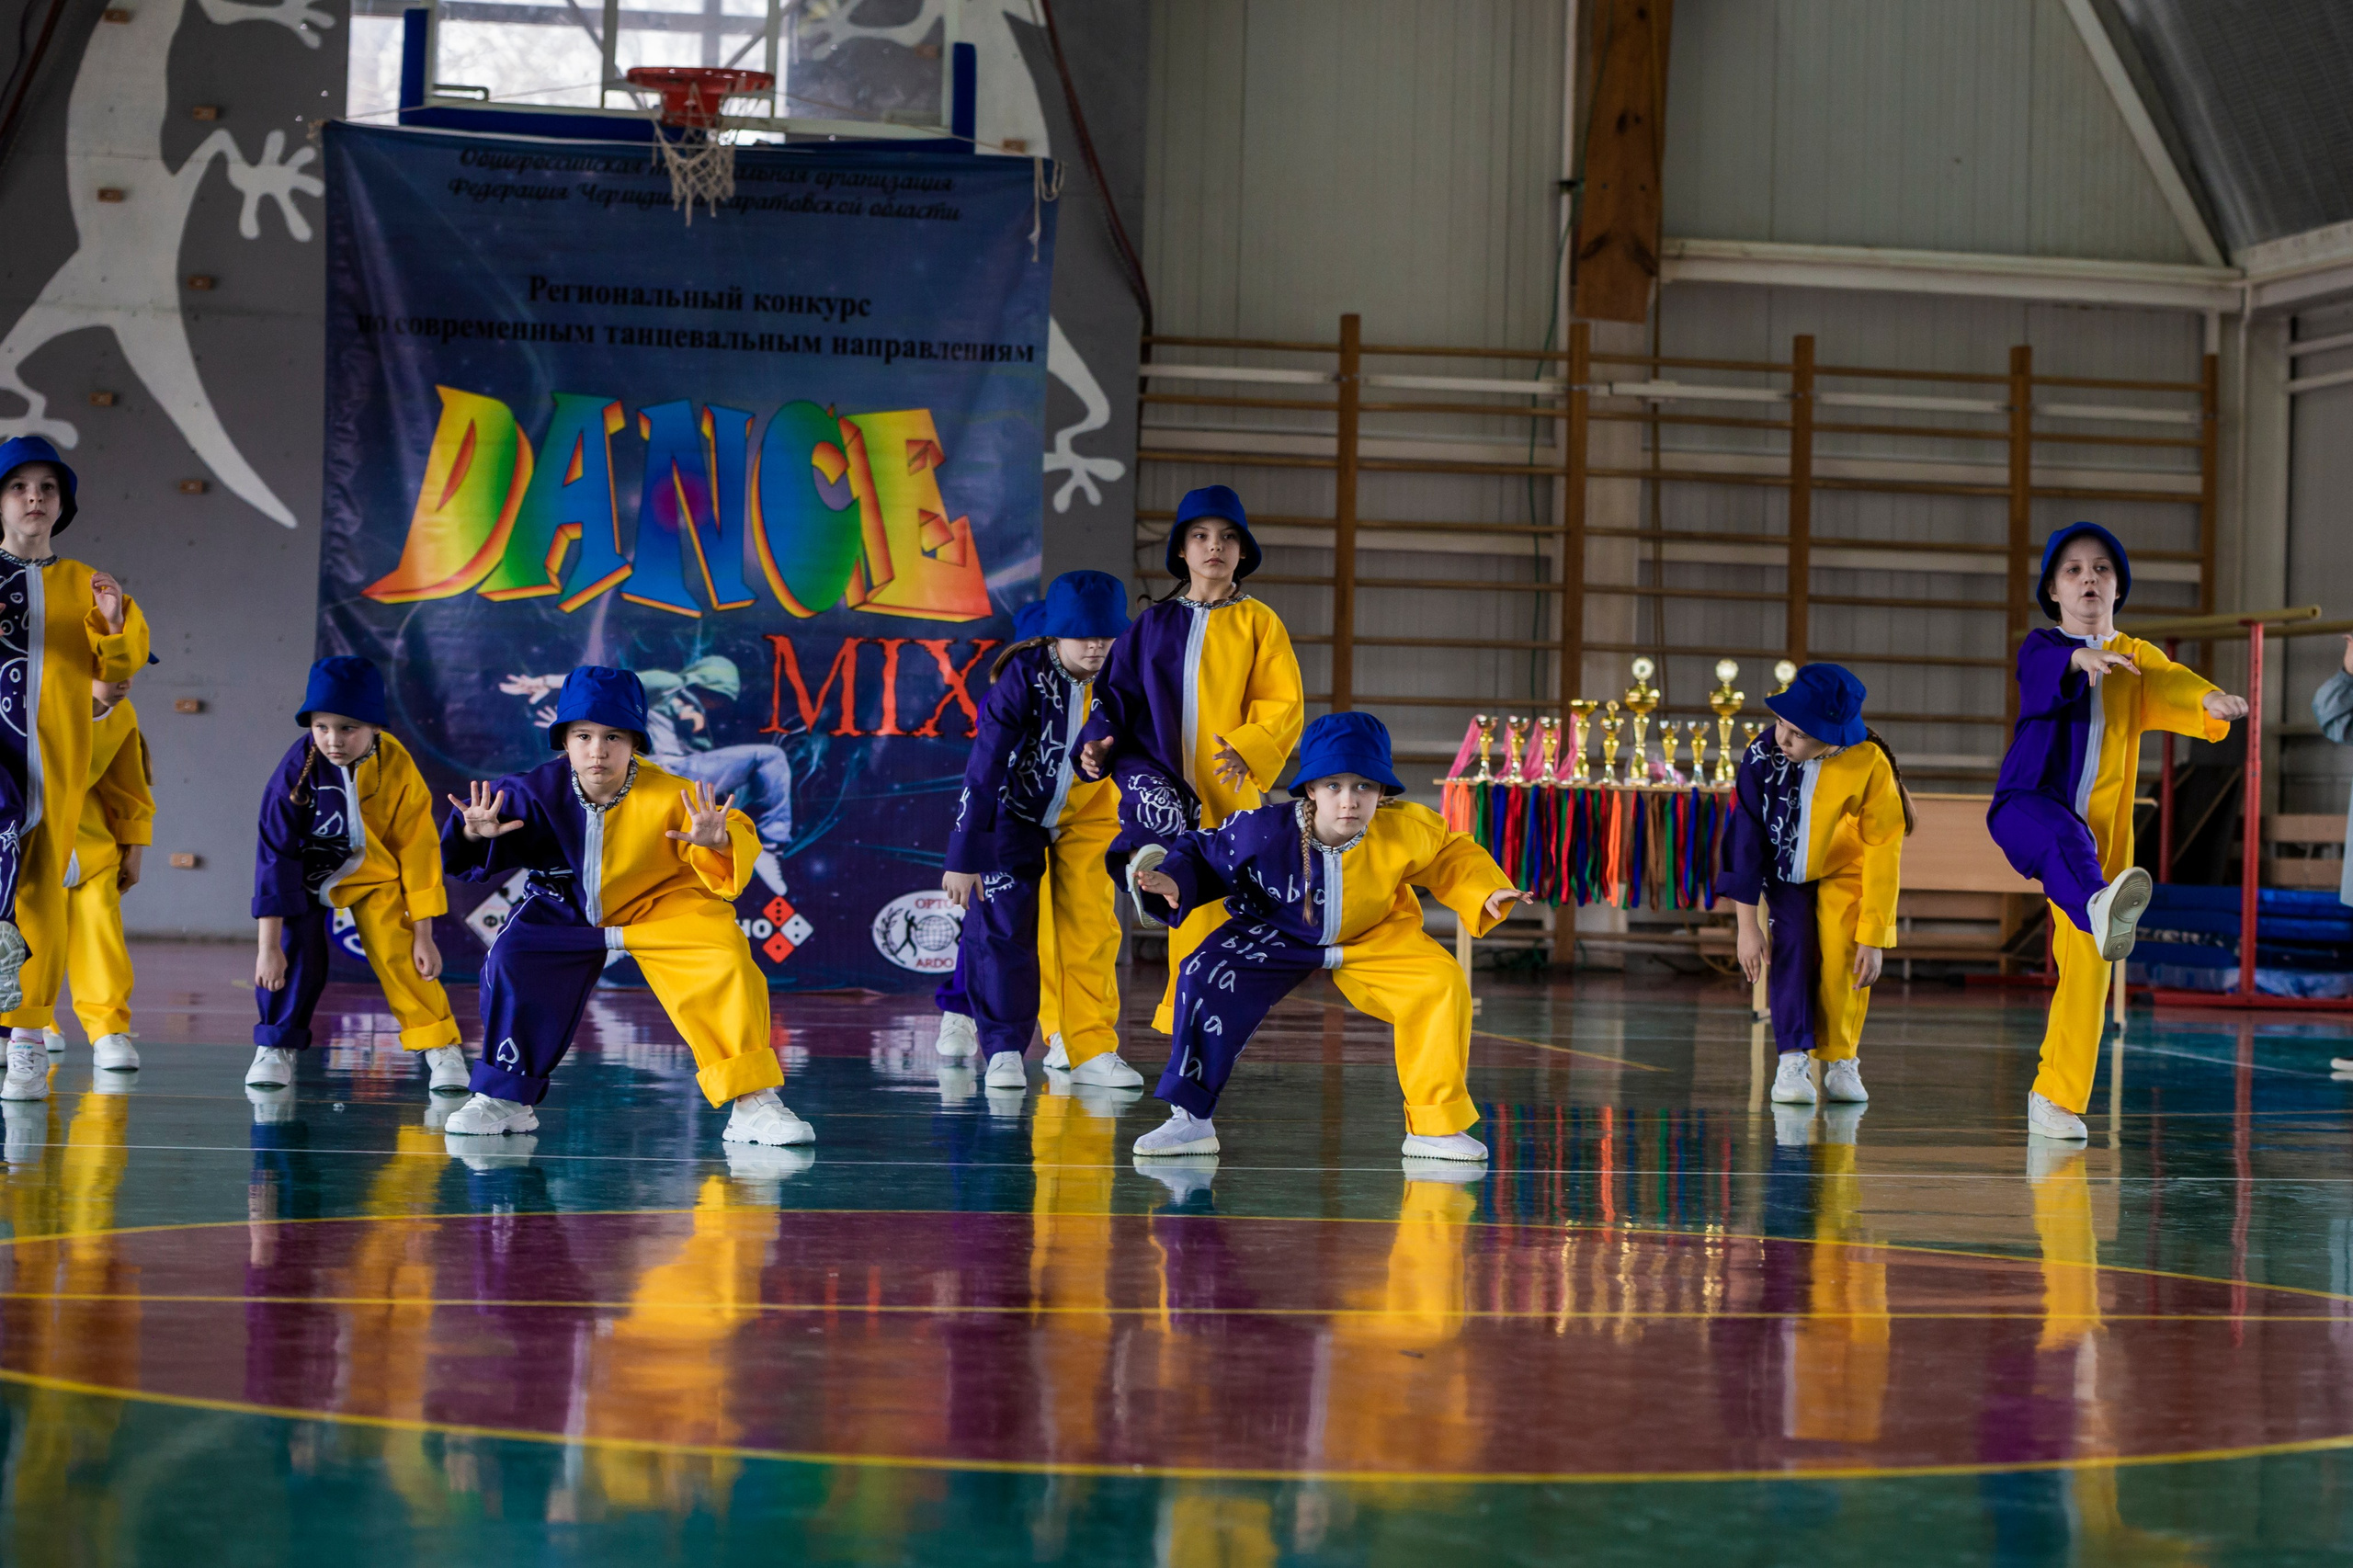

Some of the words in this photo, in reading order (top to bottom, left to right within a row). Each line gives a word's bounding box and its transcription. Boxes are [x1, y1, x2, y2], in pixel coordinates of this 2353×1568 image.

[448, 178, 570, 203] Федерация
[870, 195, 960, 222] области
[815, 171, 954, 194] организация
[529, 275, 744, 312] Региональный
[753, 292, 872, 323] конкурс
[357, 313, 388, 335] по
[394, 315, 595, 345] современным
[605, 324, 823, 356] танцевальным
[832, 333, 1035, 365] направлениям
[359, 383, 994, 624] DANCE
[759, 634, 1003, 739] MIX
[915, 958, 955, 969] ARDO
